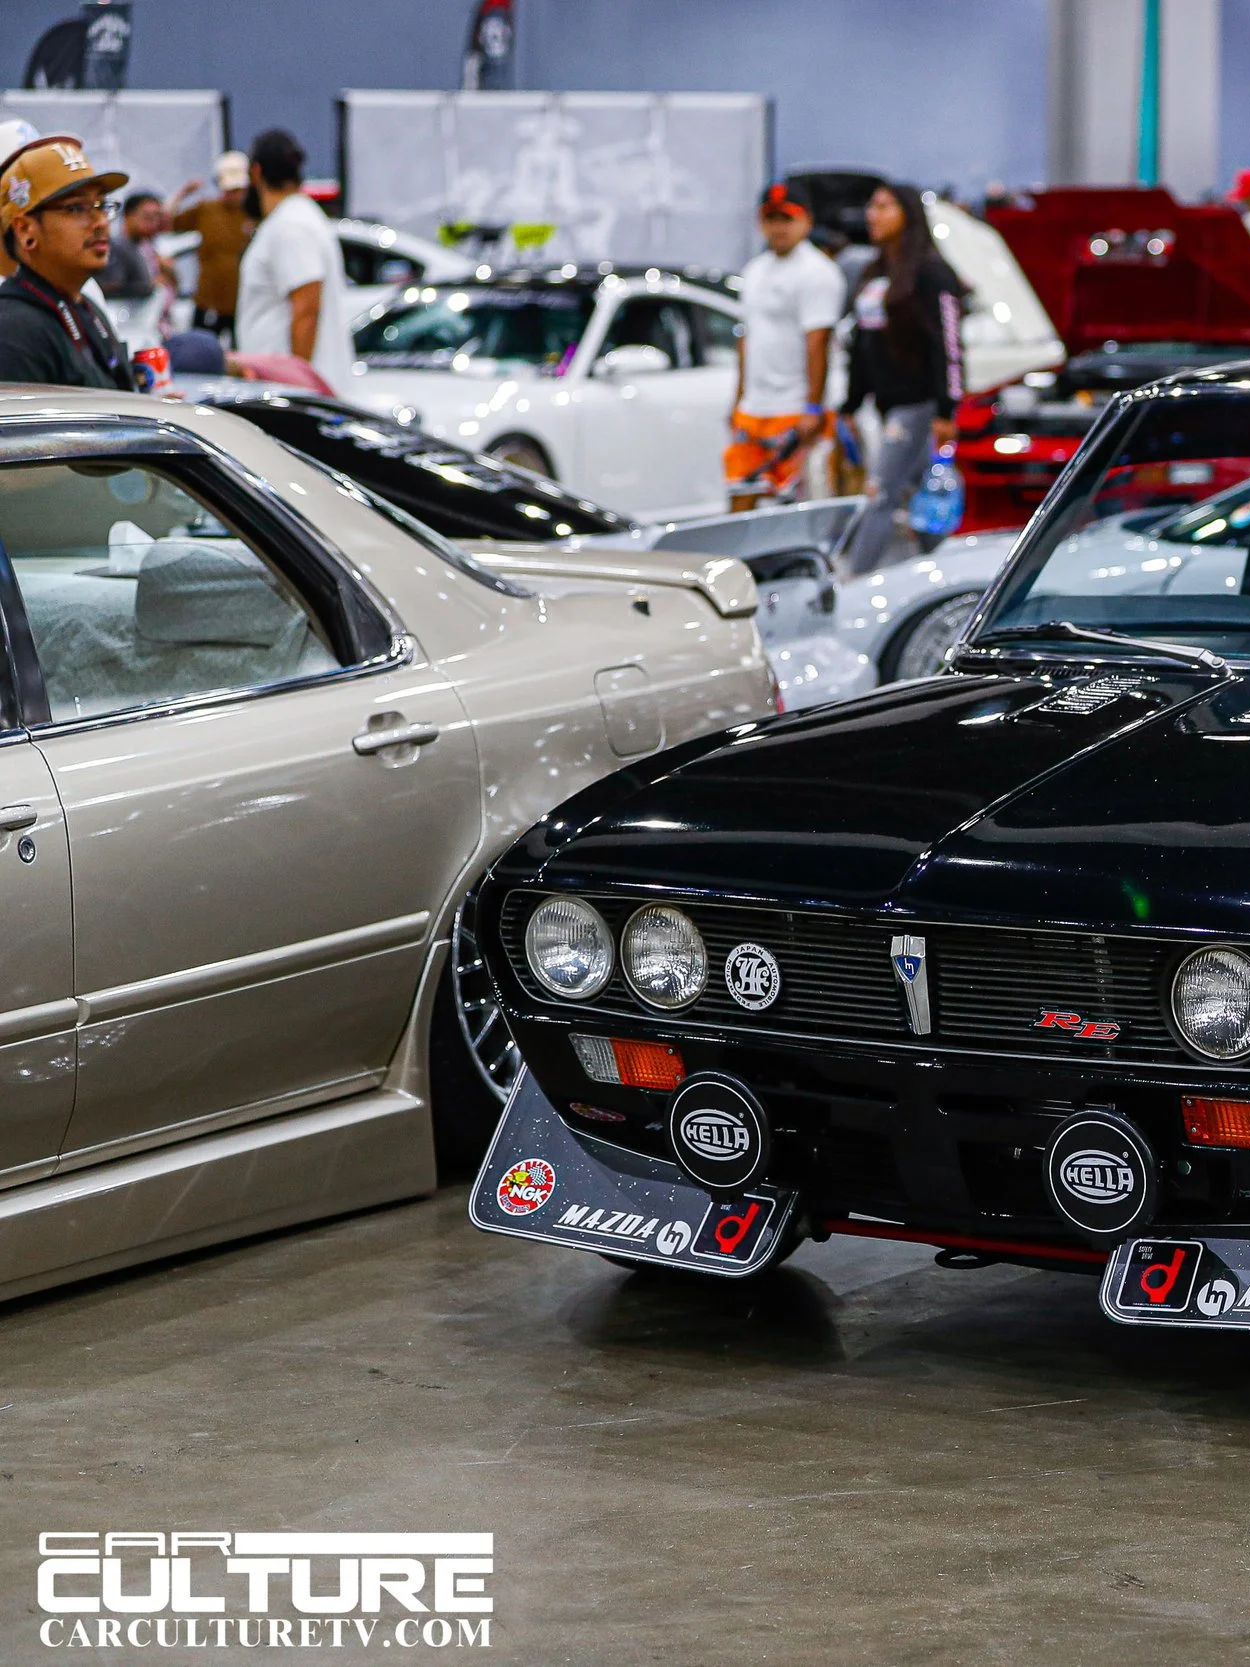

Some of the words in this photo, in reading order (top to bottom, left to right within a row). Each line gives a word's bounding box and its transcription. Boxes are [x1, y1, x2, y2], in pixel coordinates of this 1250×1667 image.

[736, 946, 764, 956] JAPAN
[726, 959, 751, 1007] FEDERATION
[758, 962, 778, 1007] AUTOMOBILE
[1033, 1011, 1120, 1039] RE
[686, 1124, 750, 1151] HELLA
[1066, 1167, 1134, 1192] HELLA
[509, 1184, 547, 1203] NGK
[558, 1204, 660, 1238] MAZDA
